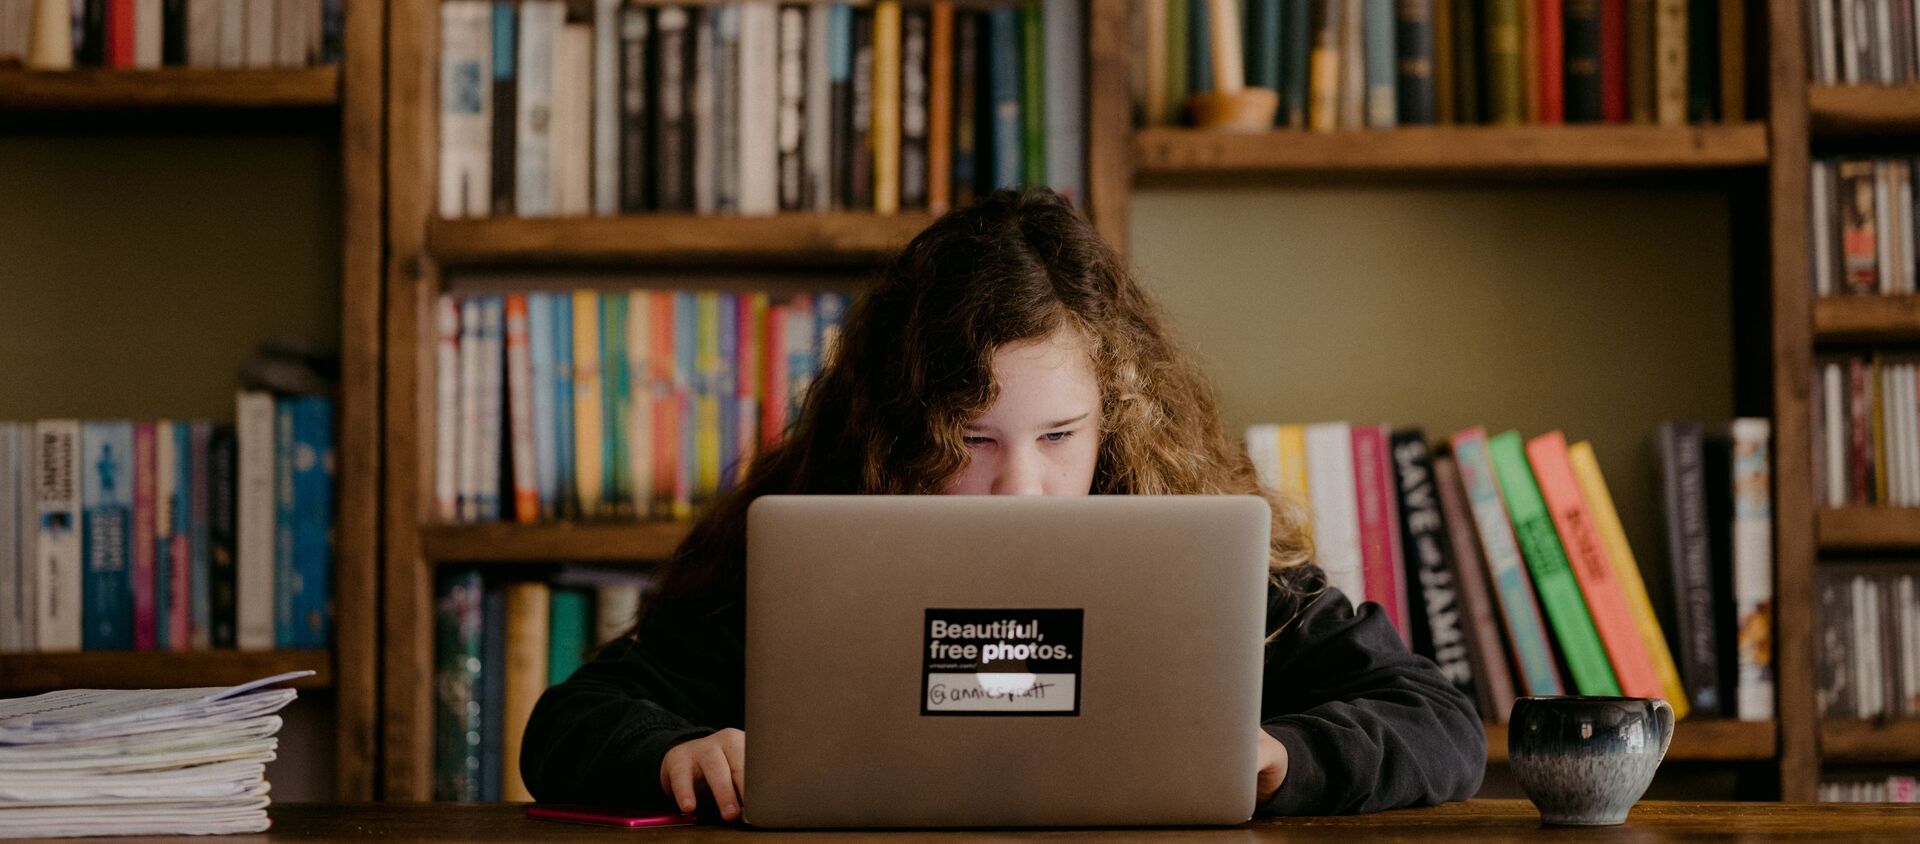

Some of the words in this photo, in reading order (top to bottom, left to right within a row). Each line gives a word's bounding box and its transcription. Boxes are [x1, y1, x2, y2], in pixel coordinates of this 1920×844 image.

[1394, 441, 1439, 535] SAVE
[1419, 567, 1472, 684] JAMIE
[931, 620, 1044, 641] Beautiful,
[930, 640, 978, 659] free
[982, 641, 1073, 664] photos.
